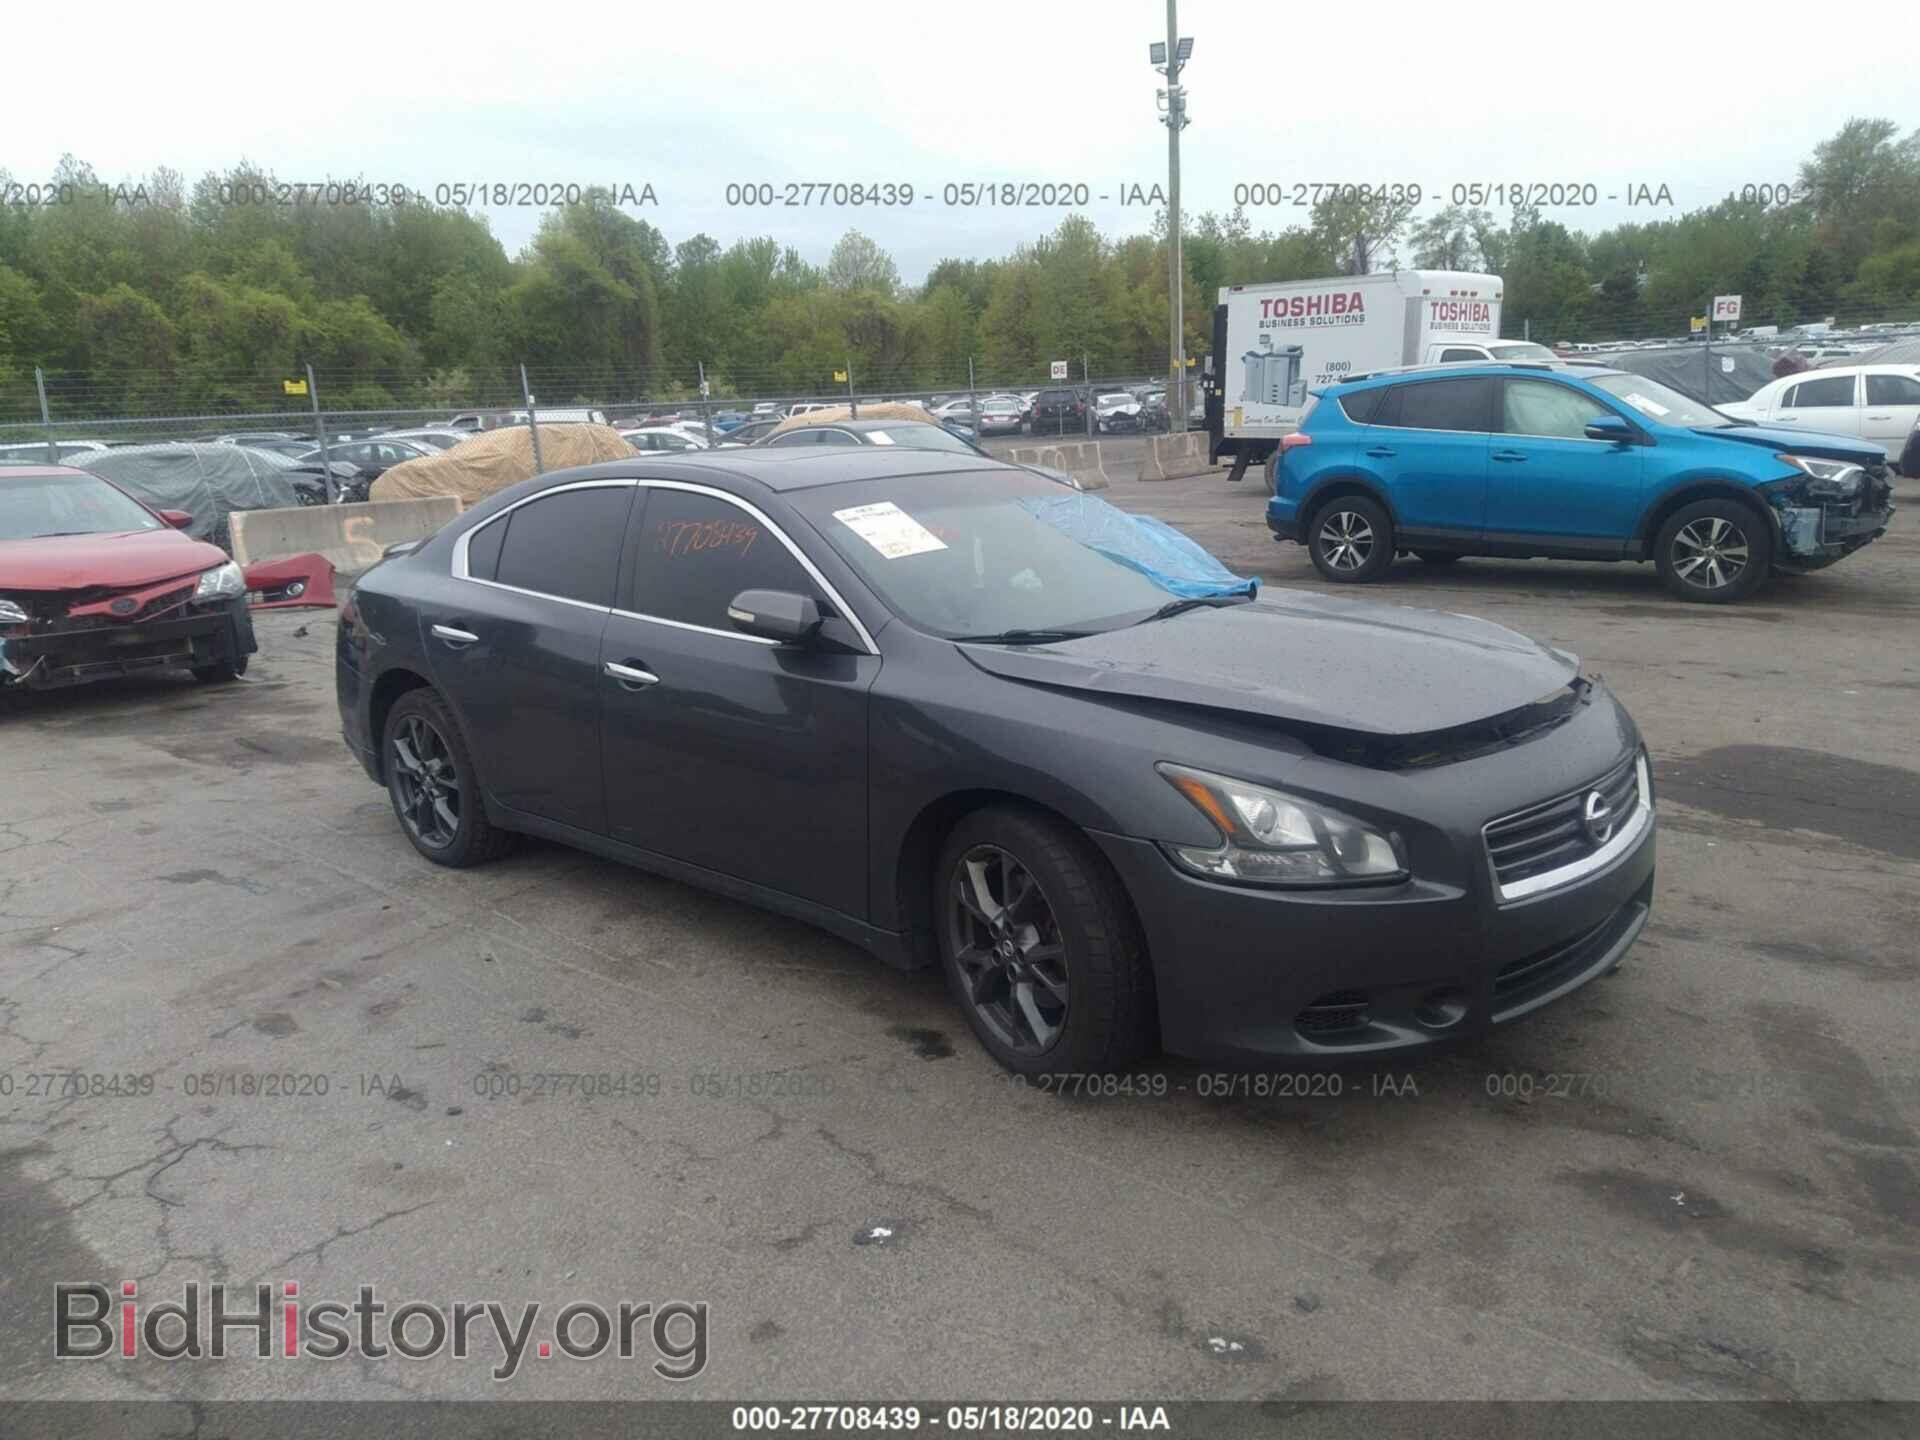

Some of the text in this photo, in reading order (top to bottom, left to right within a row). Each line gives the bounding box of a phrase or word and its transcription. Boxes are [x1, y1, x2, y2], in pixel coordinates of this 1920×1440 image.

[1260, 292, 1364, 319] TOSHIBA
[1430, 302, 1490, 321] TOSHIBA
[1716, 301, 1738, 315] FG
[1259, 314, 1366, 329] BUSINESS SOLUTIONS
[1053, 365, 1066, 375] DE
[1325, 360, 1352, 372] (800)
[1315, 374, 1348, 384] 727-4
